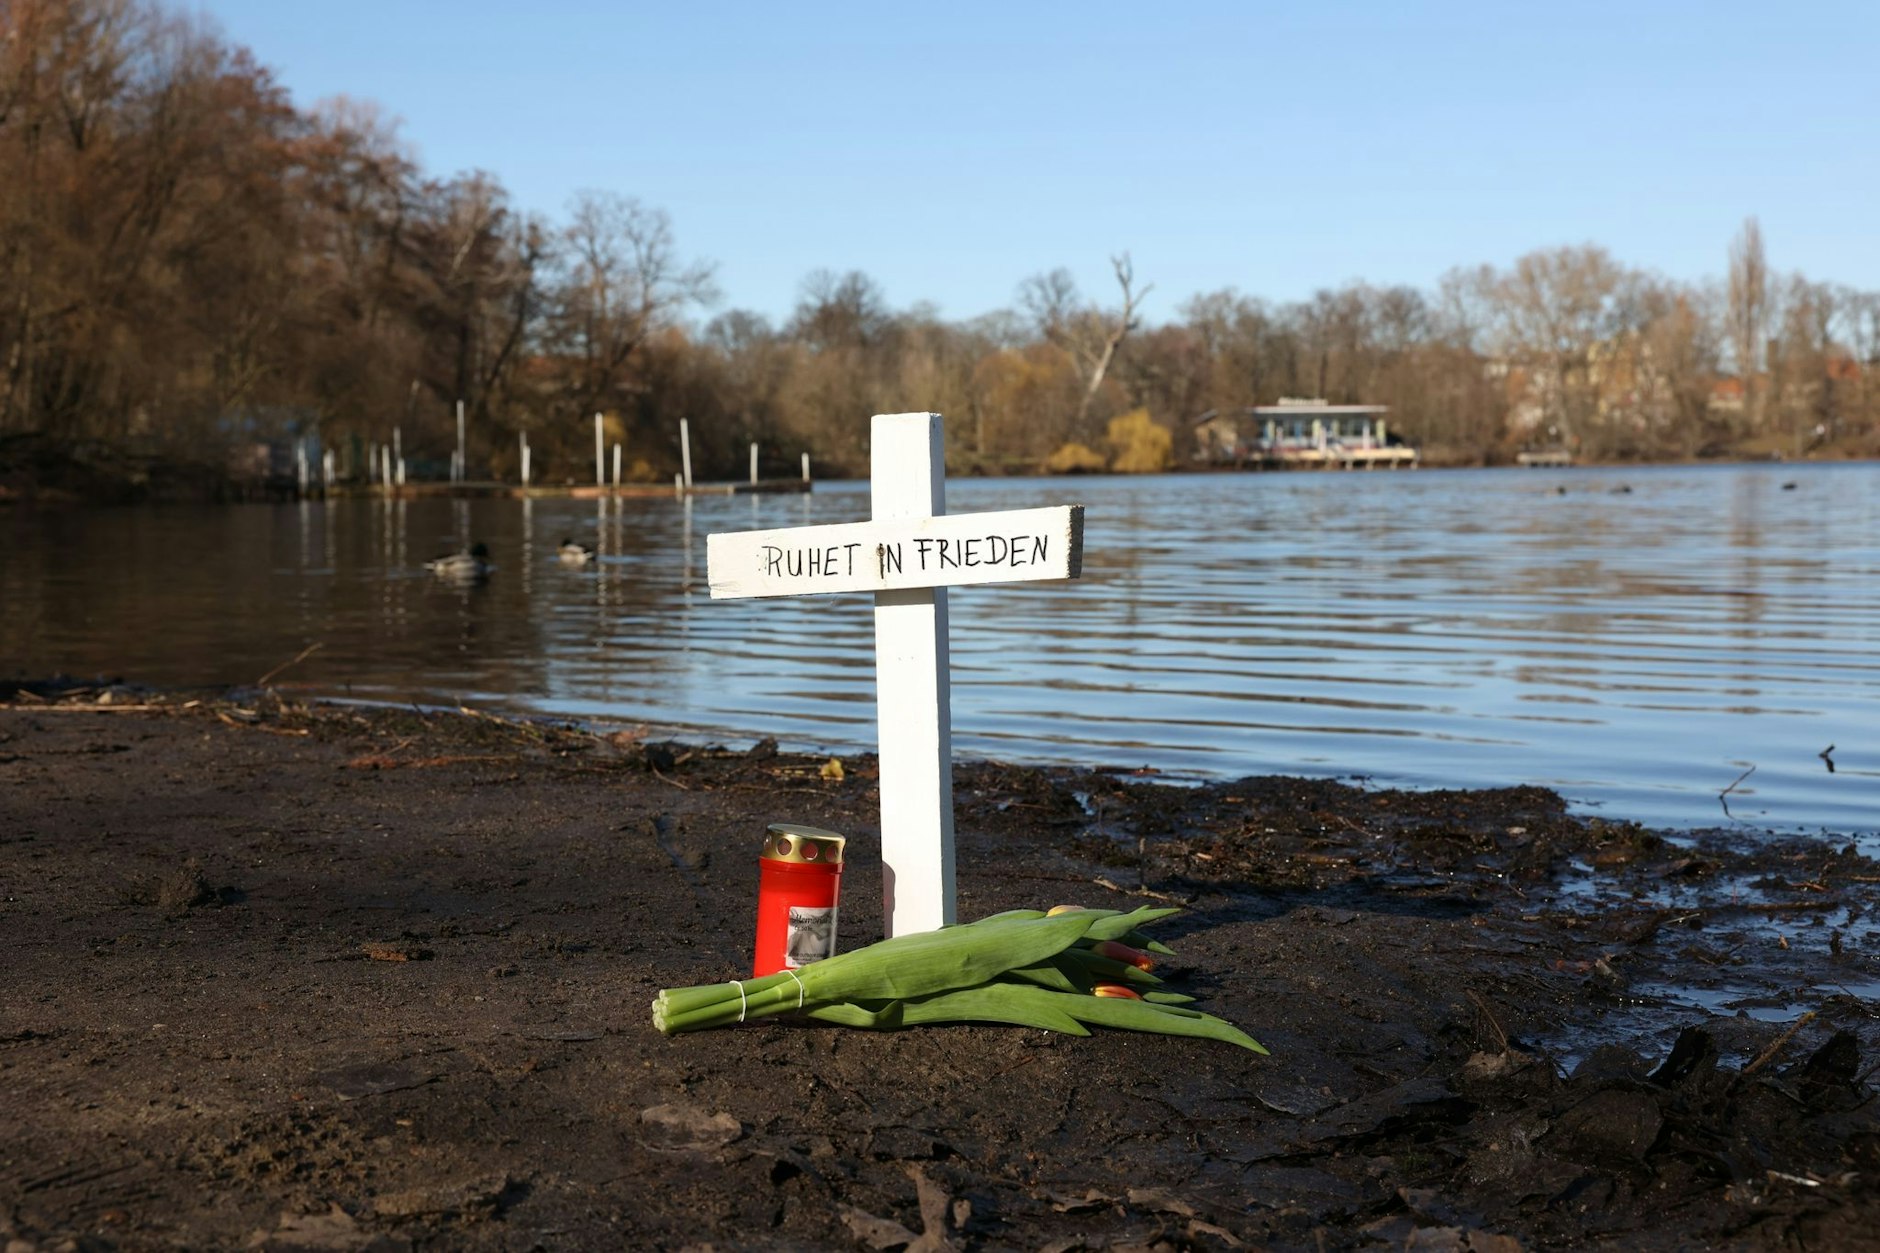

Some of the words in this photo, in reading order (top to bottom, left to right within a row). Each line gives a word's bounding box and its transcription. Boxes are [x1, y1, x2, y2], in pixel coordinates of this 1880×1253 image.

[763, 543, 861, 577] RUHET
[878, 543, 902, 579] IN
[913, 535, 1048, 570] FRIEDEN
